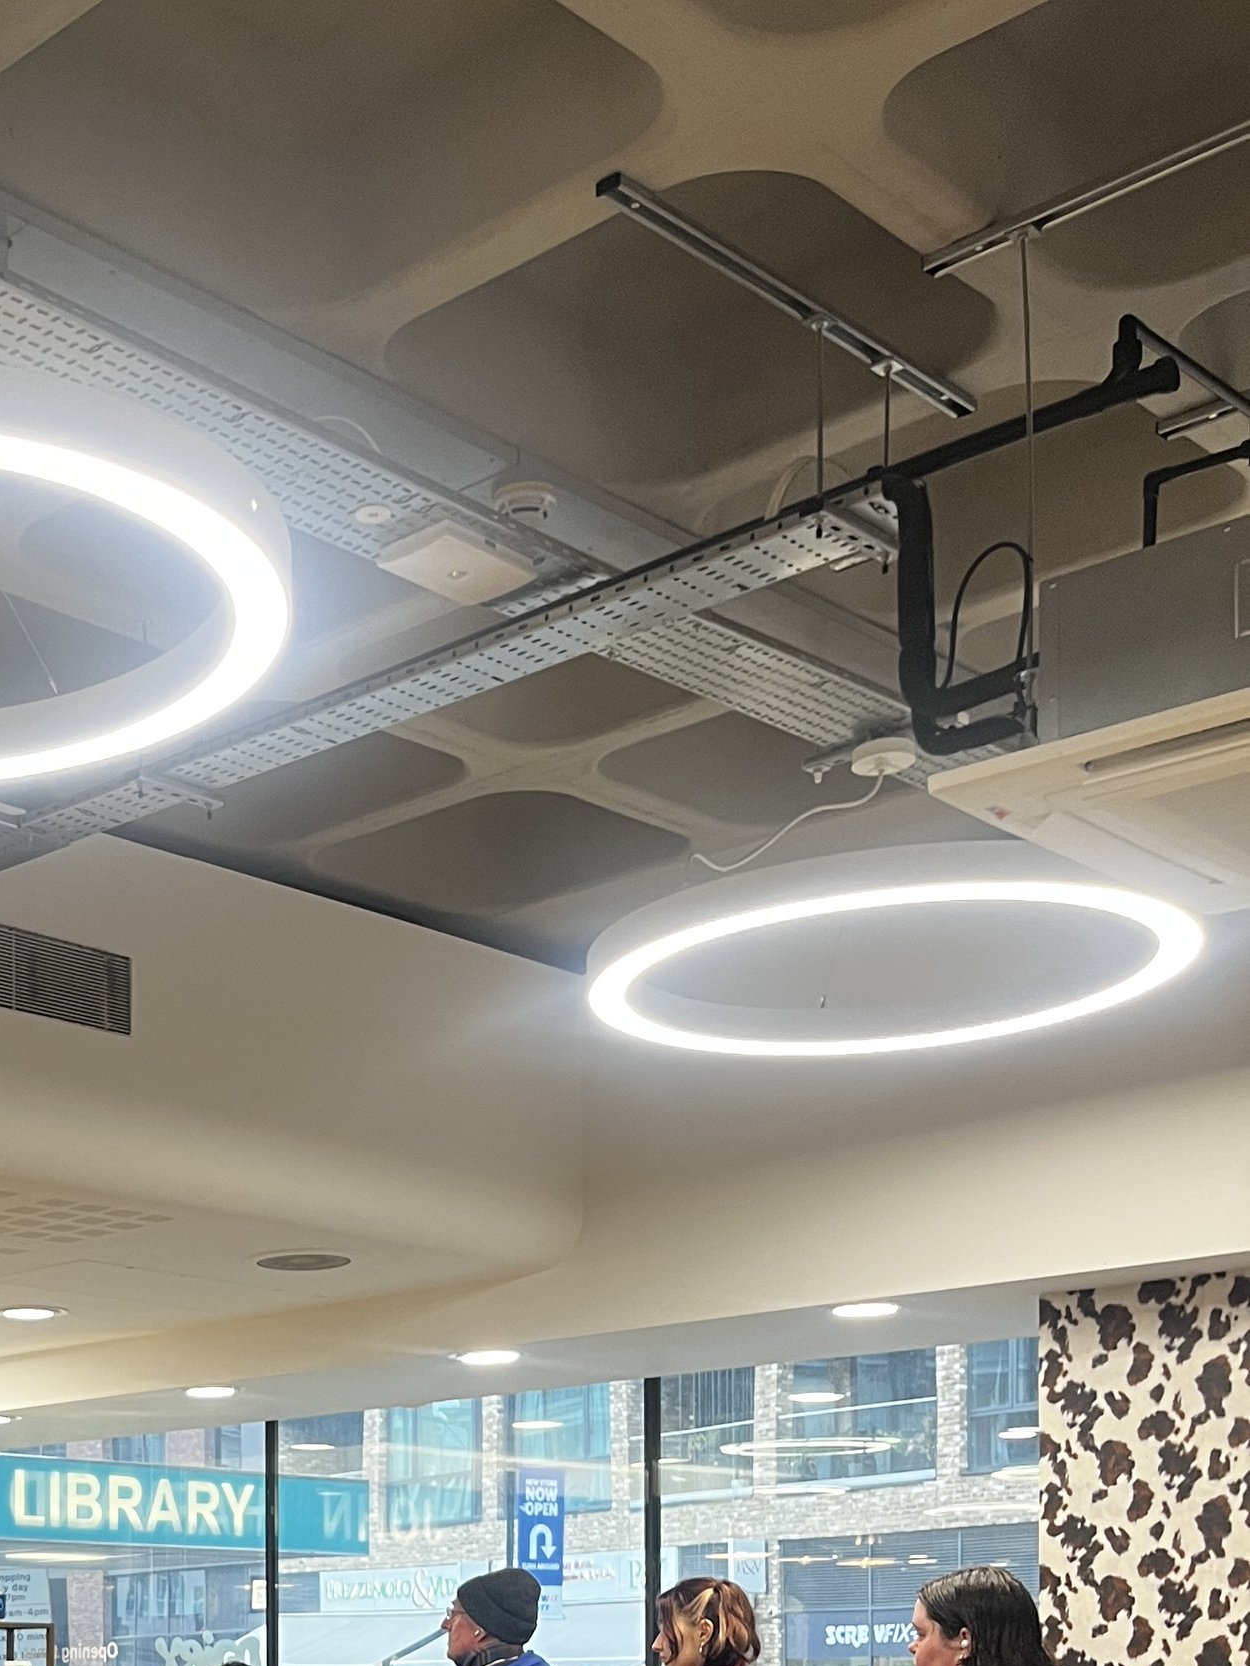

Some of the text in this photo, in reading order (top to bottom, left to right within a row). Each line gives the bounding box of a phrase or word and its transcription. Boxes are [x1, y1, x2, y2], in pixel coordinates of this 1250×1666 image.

[525, 1486, 558, 1502] NOW
[13, 1468, 256, 1537] LIBRARY
[525, 1502, 558, 1517] OPEN
